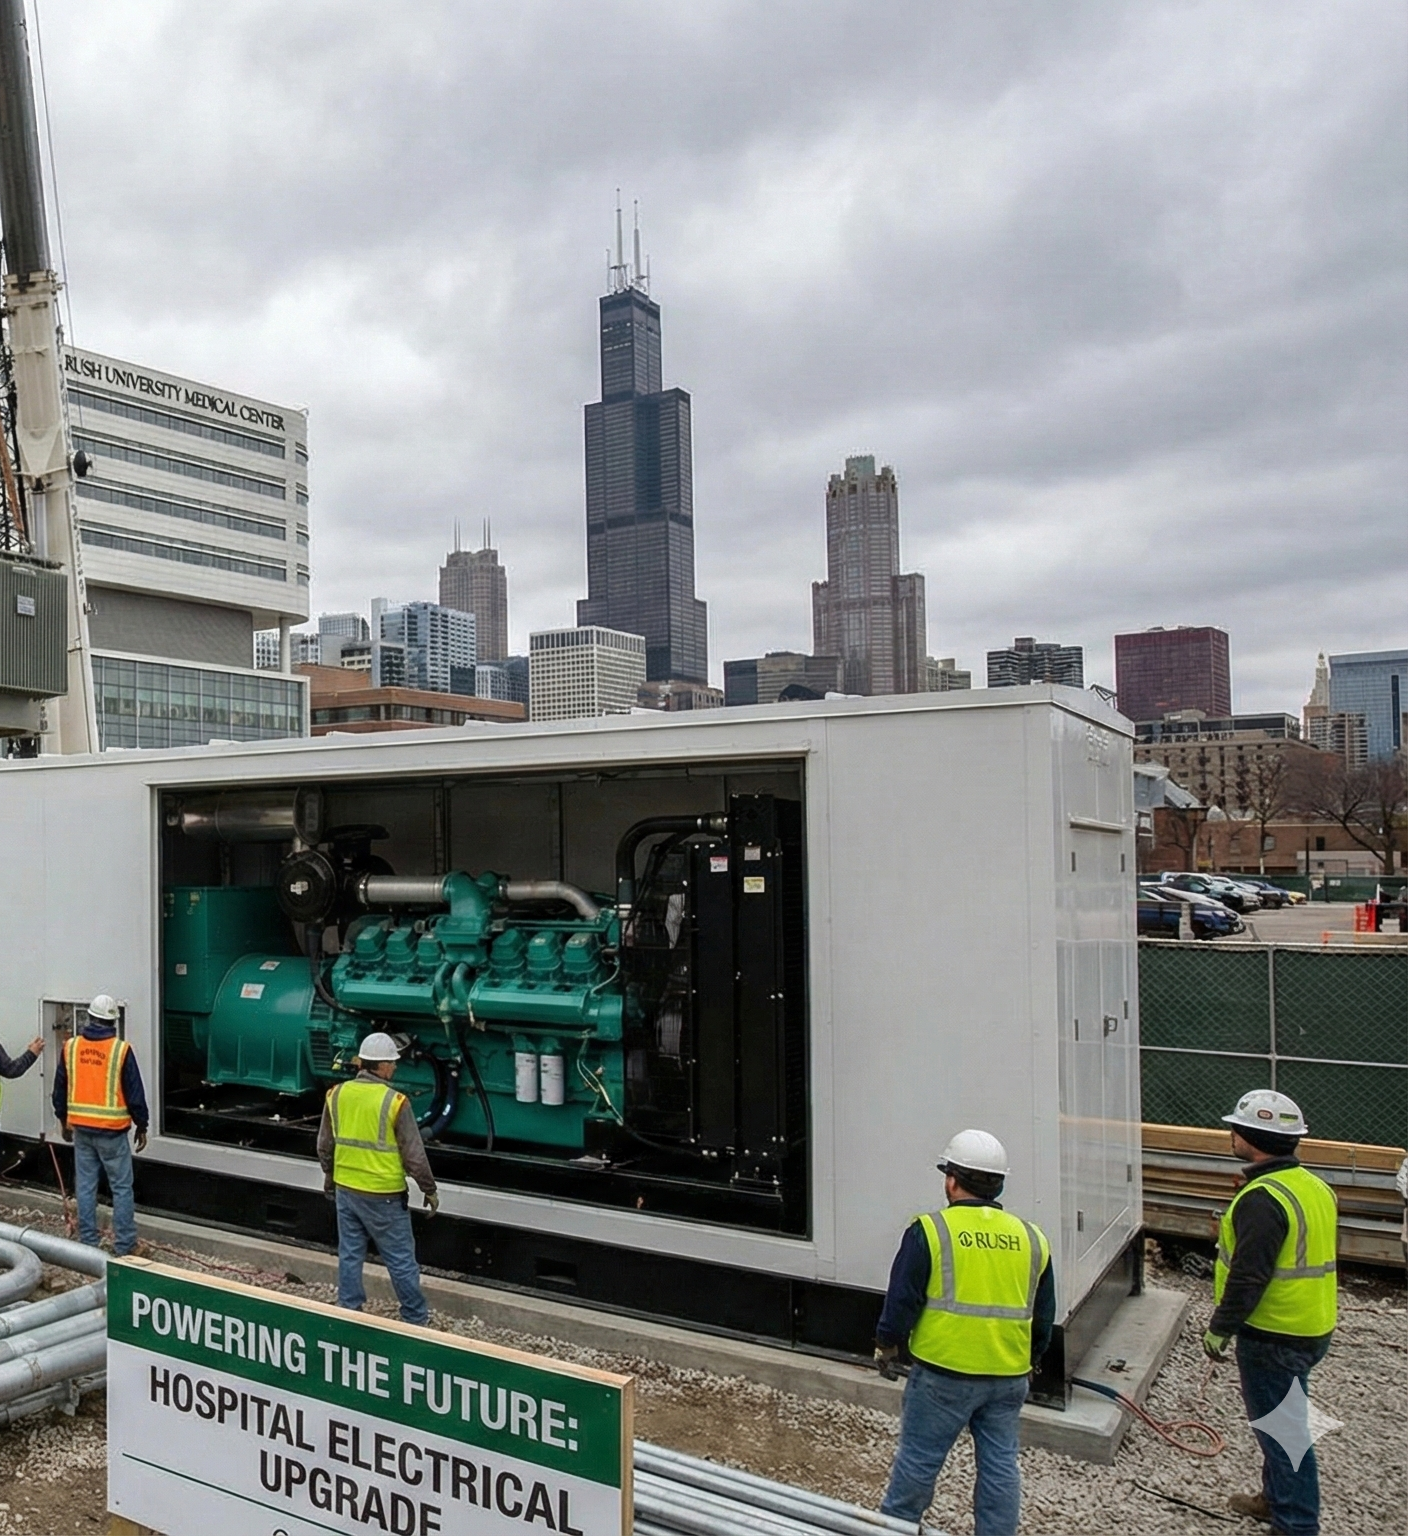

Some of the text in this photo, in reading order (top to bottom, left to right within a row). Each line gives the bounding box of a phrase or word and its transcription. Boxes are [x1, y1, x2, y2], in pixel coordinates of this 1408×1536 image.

[64, 354, 286, 431] RUSH UNIVERSITY MEDICAL CENTER
[974, 1231, 1021, 1251] RUSH
[132, 1291, 579, 1451] POWERING THE FUTURE:
[149, 1365, 584, 1536] HOSPITAL ELECTRICAL
